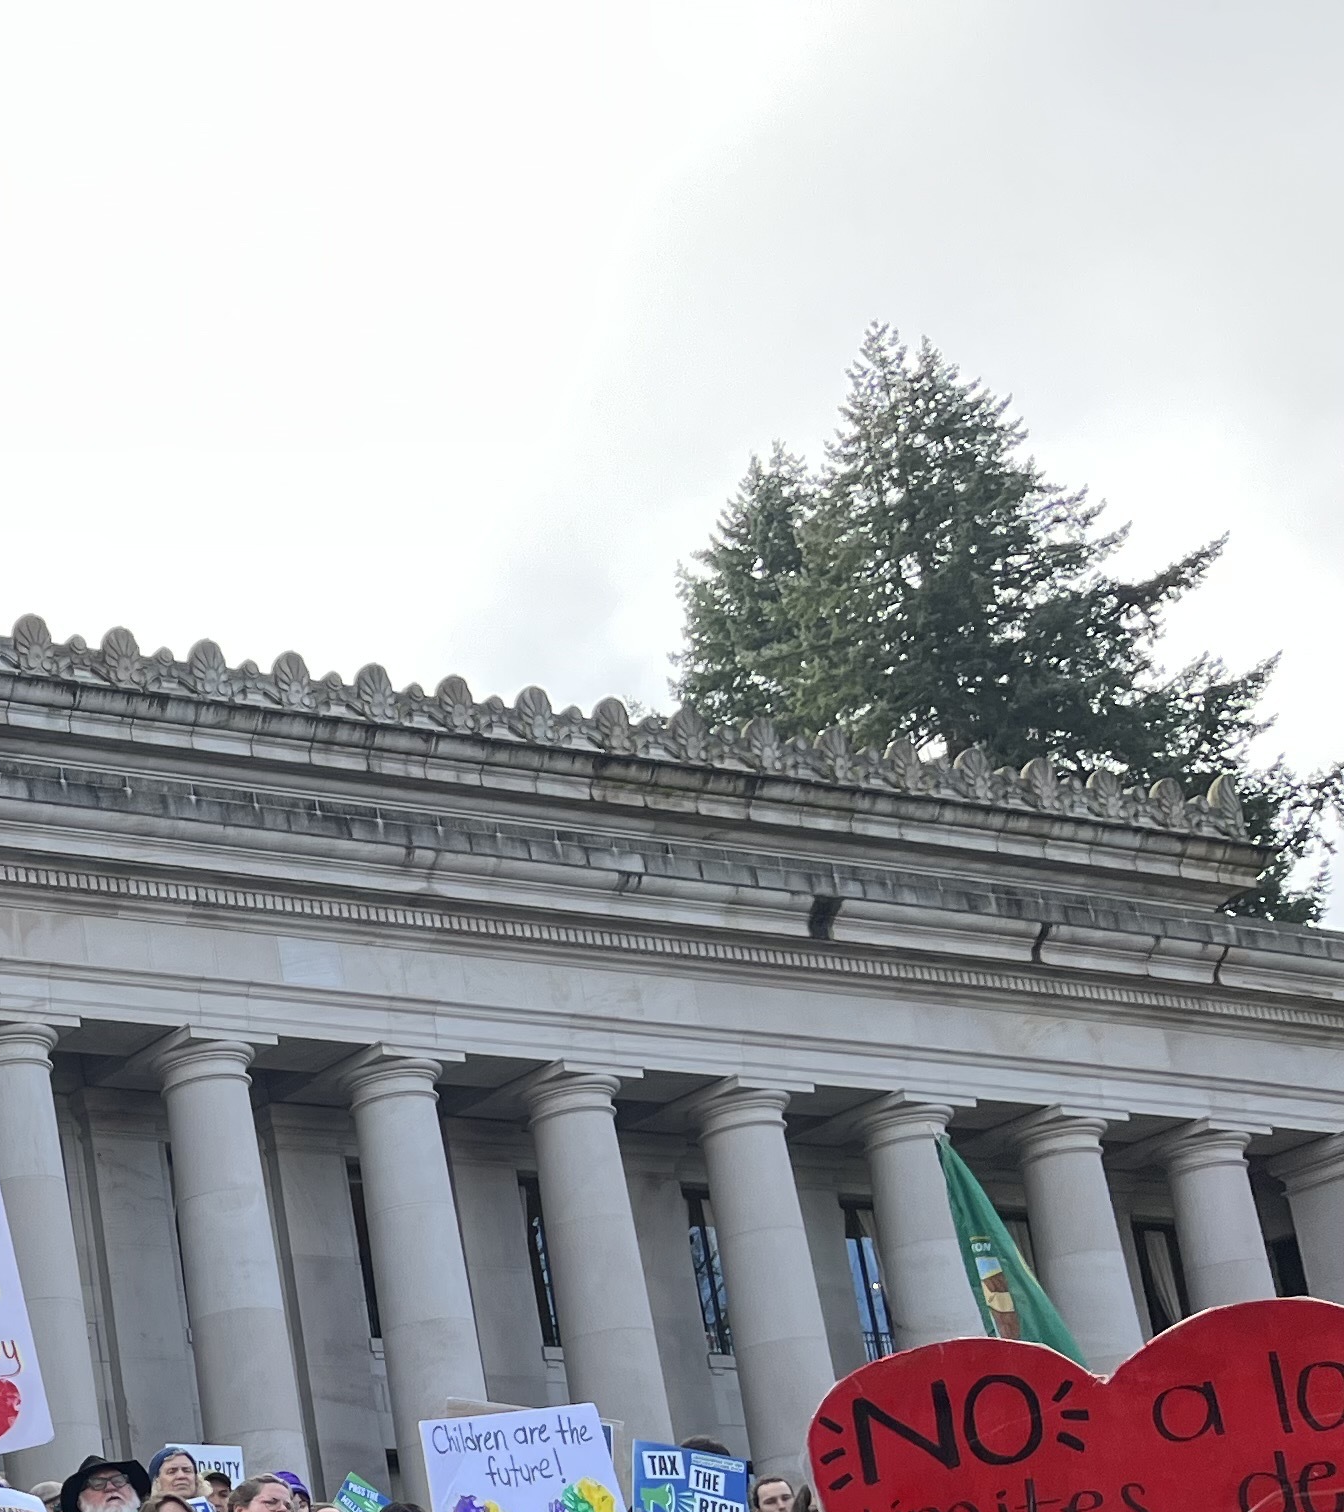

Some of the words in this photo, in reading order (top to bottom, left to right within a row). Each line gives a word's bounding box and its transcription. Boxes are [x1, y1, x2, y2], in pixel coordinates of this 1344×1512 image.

[431, 1421, 510, 1456] Children
[513, 1421, 551, 1447] are
[555, 1414, 593, 1445] the
[852, 1373, 1044, 1486] NO
[1152, 1380, 1226, 1443] a
[484, 1448, 568, 1489] future!
[647, 1454, 680, 1477] TAX
[693, 1469, 720, 1493] THE
